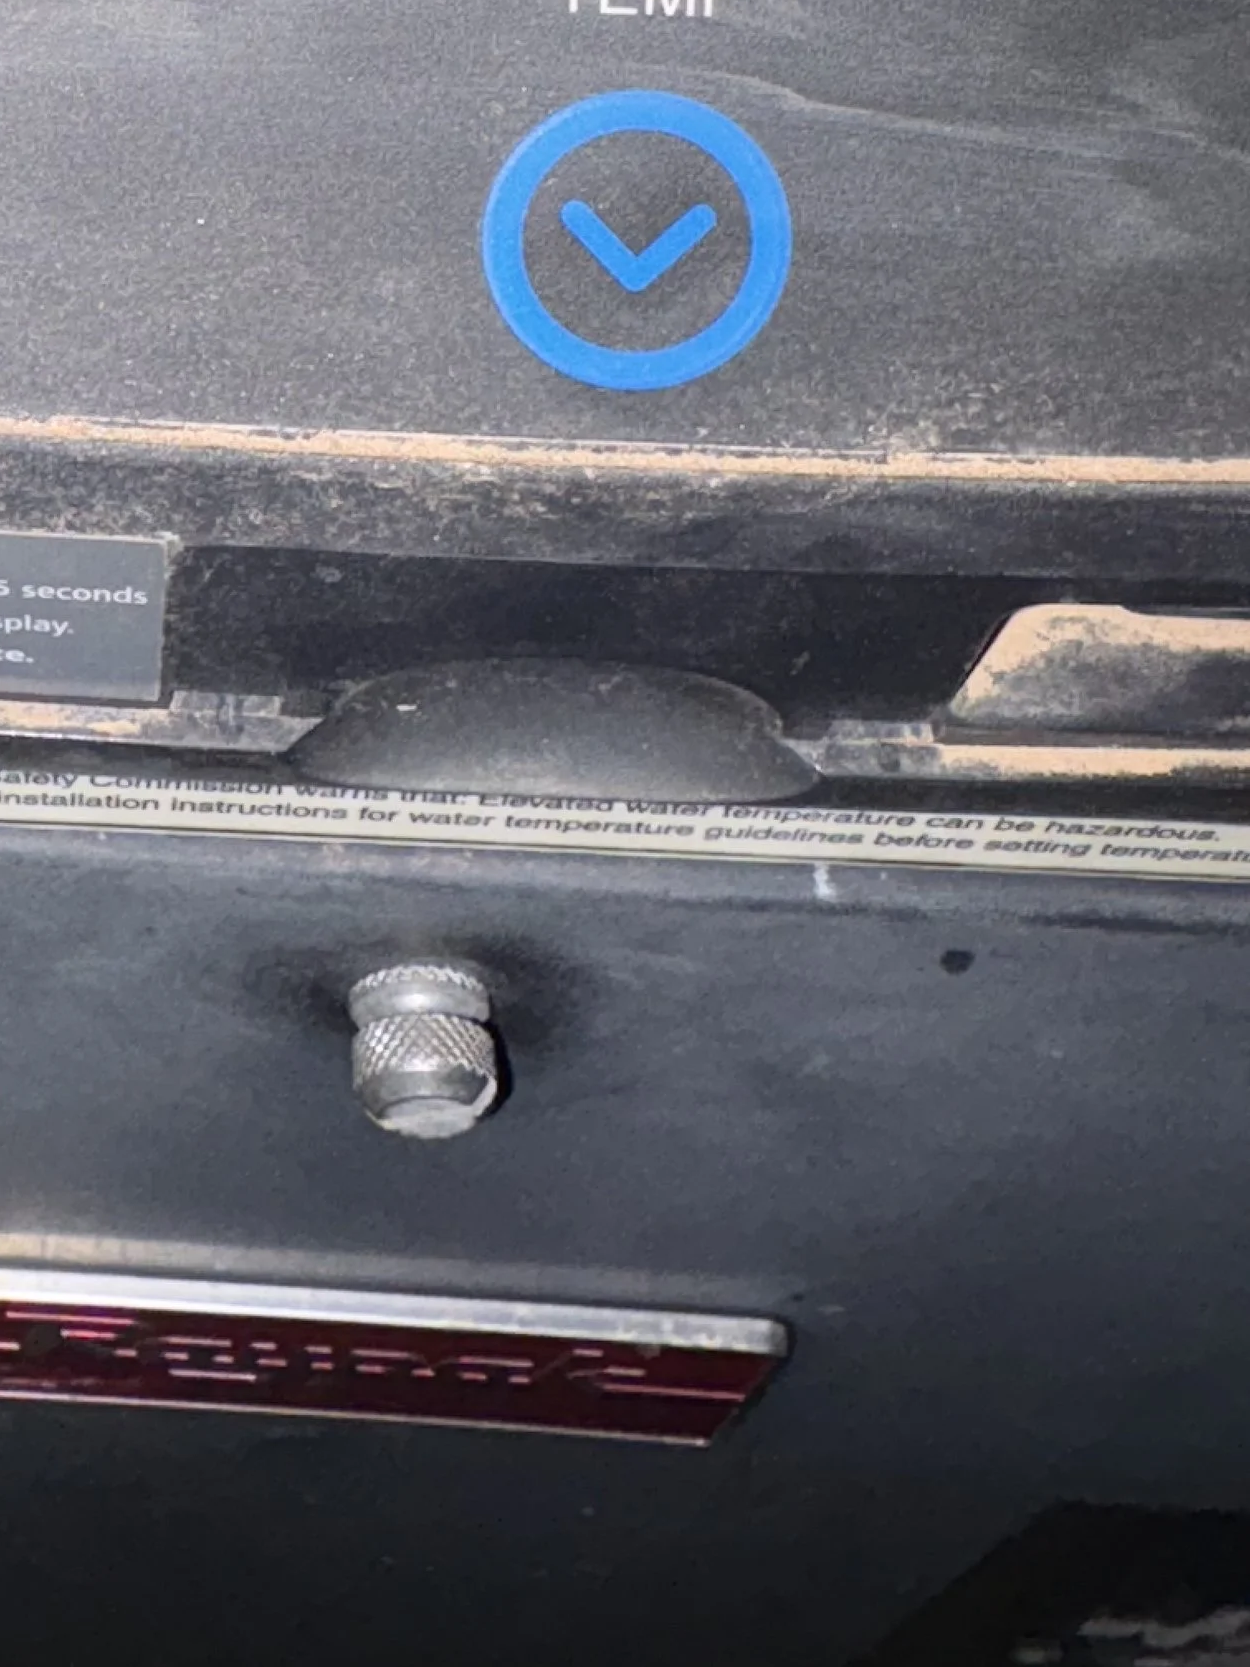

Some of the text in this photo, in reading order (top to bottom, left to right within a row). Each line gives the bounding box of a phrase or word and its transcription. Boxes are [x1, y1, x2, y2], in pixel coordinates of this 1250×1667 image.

[21, 583, 149, 605] seconds
[171, 797, 348, 820] instructions
[358, 806, 400, 822] for
[409, 811, 497, 826] water
[504, 815, 695, 836] temperature
[704, 825, 865, 844] guidelines
[874, 832, 974, 849] before
[983, 838, 1092, 857] setting
[926, 816, 984, 830] can
[994, 817, 1035, 832] be
[1045, 820, 1220, 841] hazardous.
